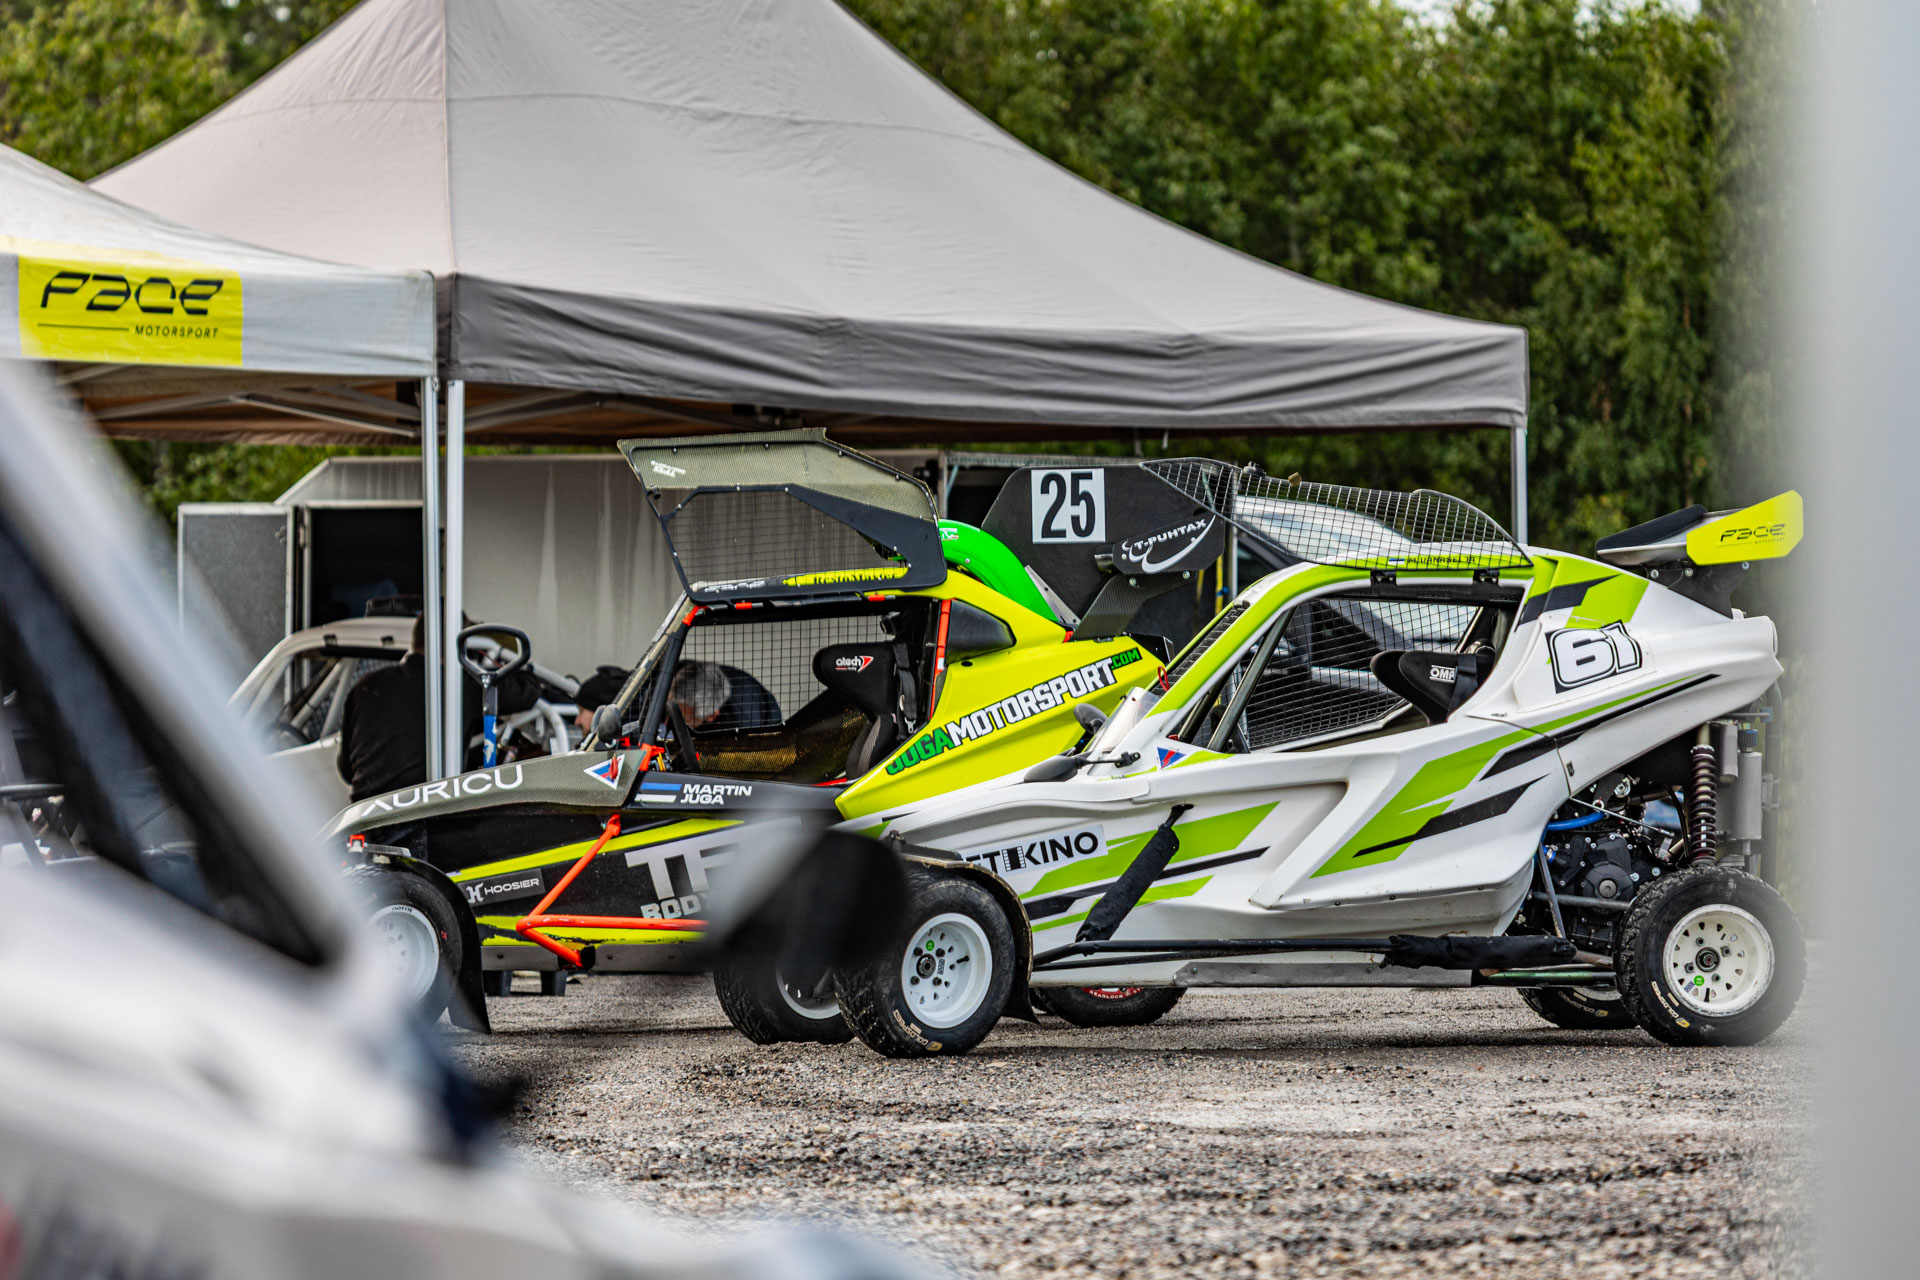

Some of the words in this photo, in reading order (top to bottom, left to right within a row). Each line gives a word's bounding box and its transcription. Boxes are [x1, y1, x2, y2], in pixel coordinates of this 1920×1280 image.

[134, 325, 218, 338] MOTORSPORT
[1040, 471, 1096, 539] 25
[1133, 518, 1207, 550] T-PUHTAX
[1545, 619, 1642, 694] 61
[361, 764, 523, 816] AURICU
[680, 794, 724, 805] JUGA
[683, 783, 752, 796] MARTIN
[484, 878, 539, 895] HOOSIER
[893, 1009, 929, 1046] GOLDSPEED
